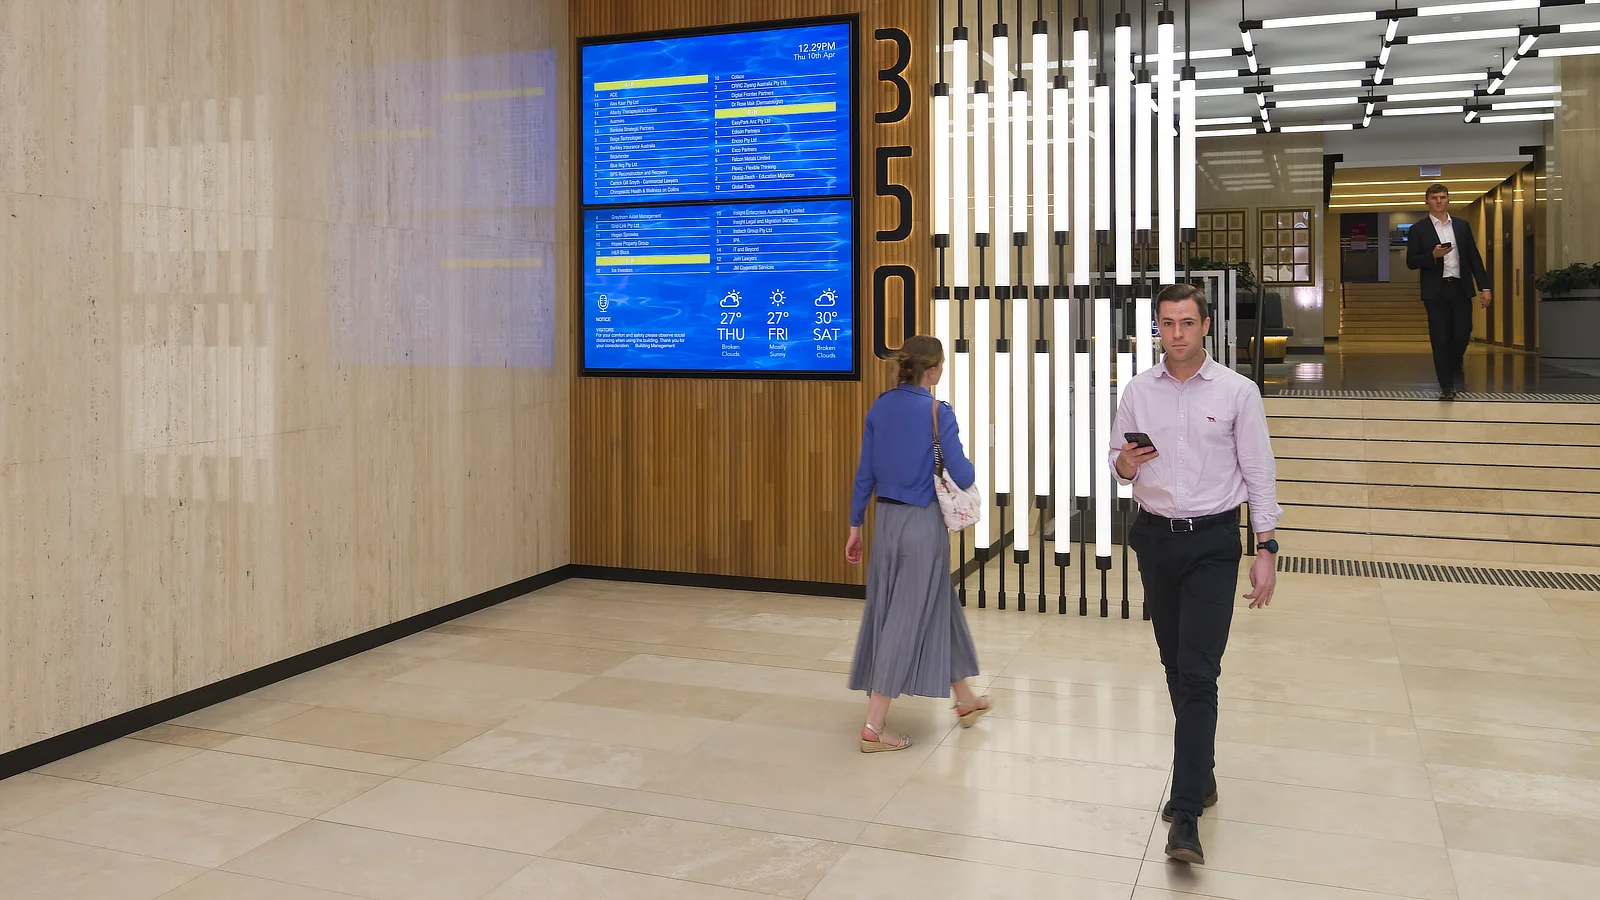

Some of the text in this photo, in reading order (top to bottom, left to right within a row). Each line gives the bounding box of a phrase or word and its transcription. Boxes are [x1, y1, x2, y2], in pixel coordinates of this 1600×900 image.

[799, 42, 836, 52] 12.29PM
[874, 28, 916, 360] 350
[720, 312, 742, 324] 27°
[767, 312, 788, 324] 27°
[815, 312, 837, 324] 30°
[717, 328, 745, 340] THU
[769, 328, 788, 340] FRI
[813, 328, 840, 340] SAT
